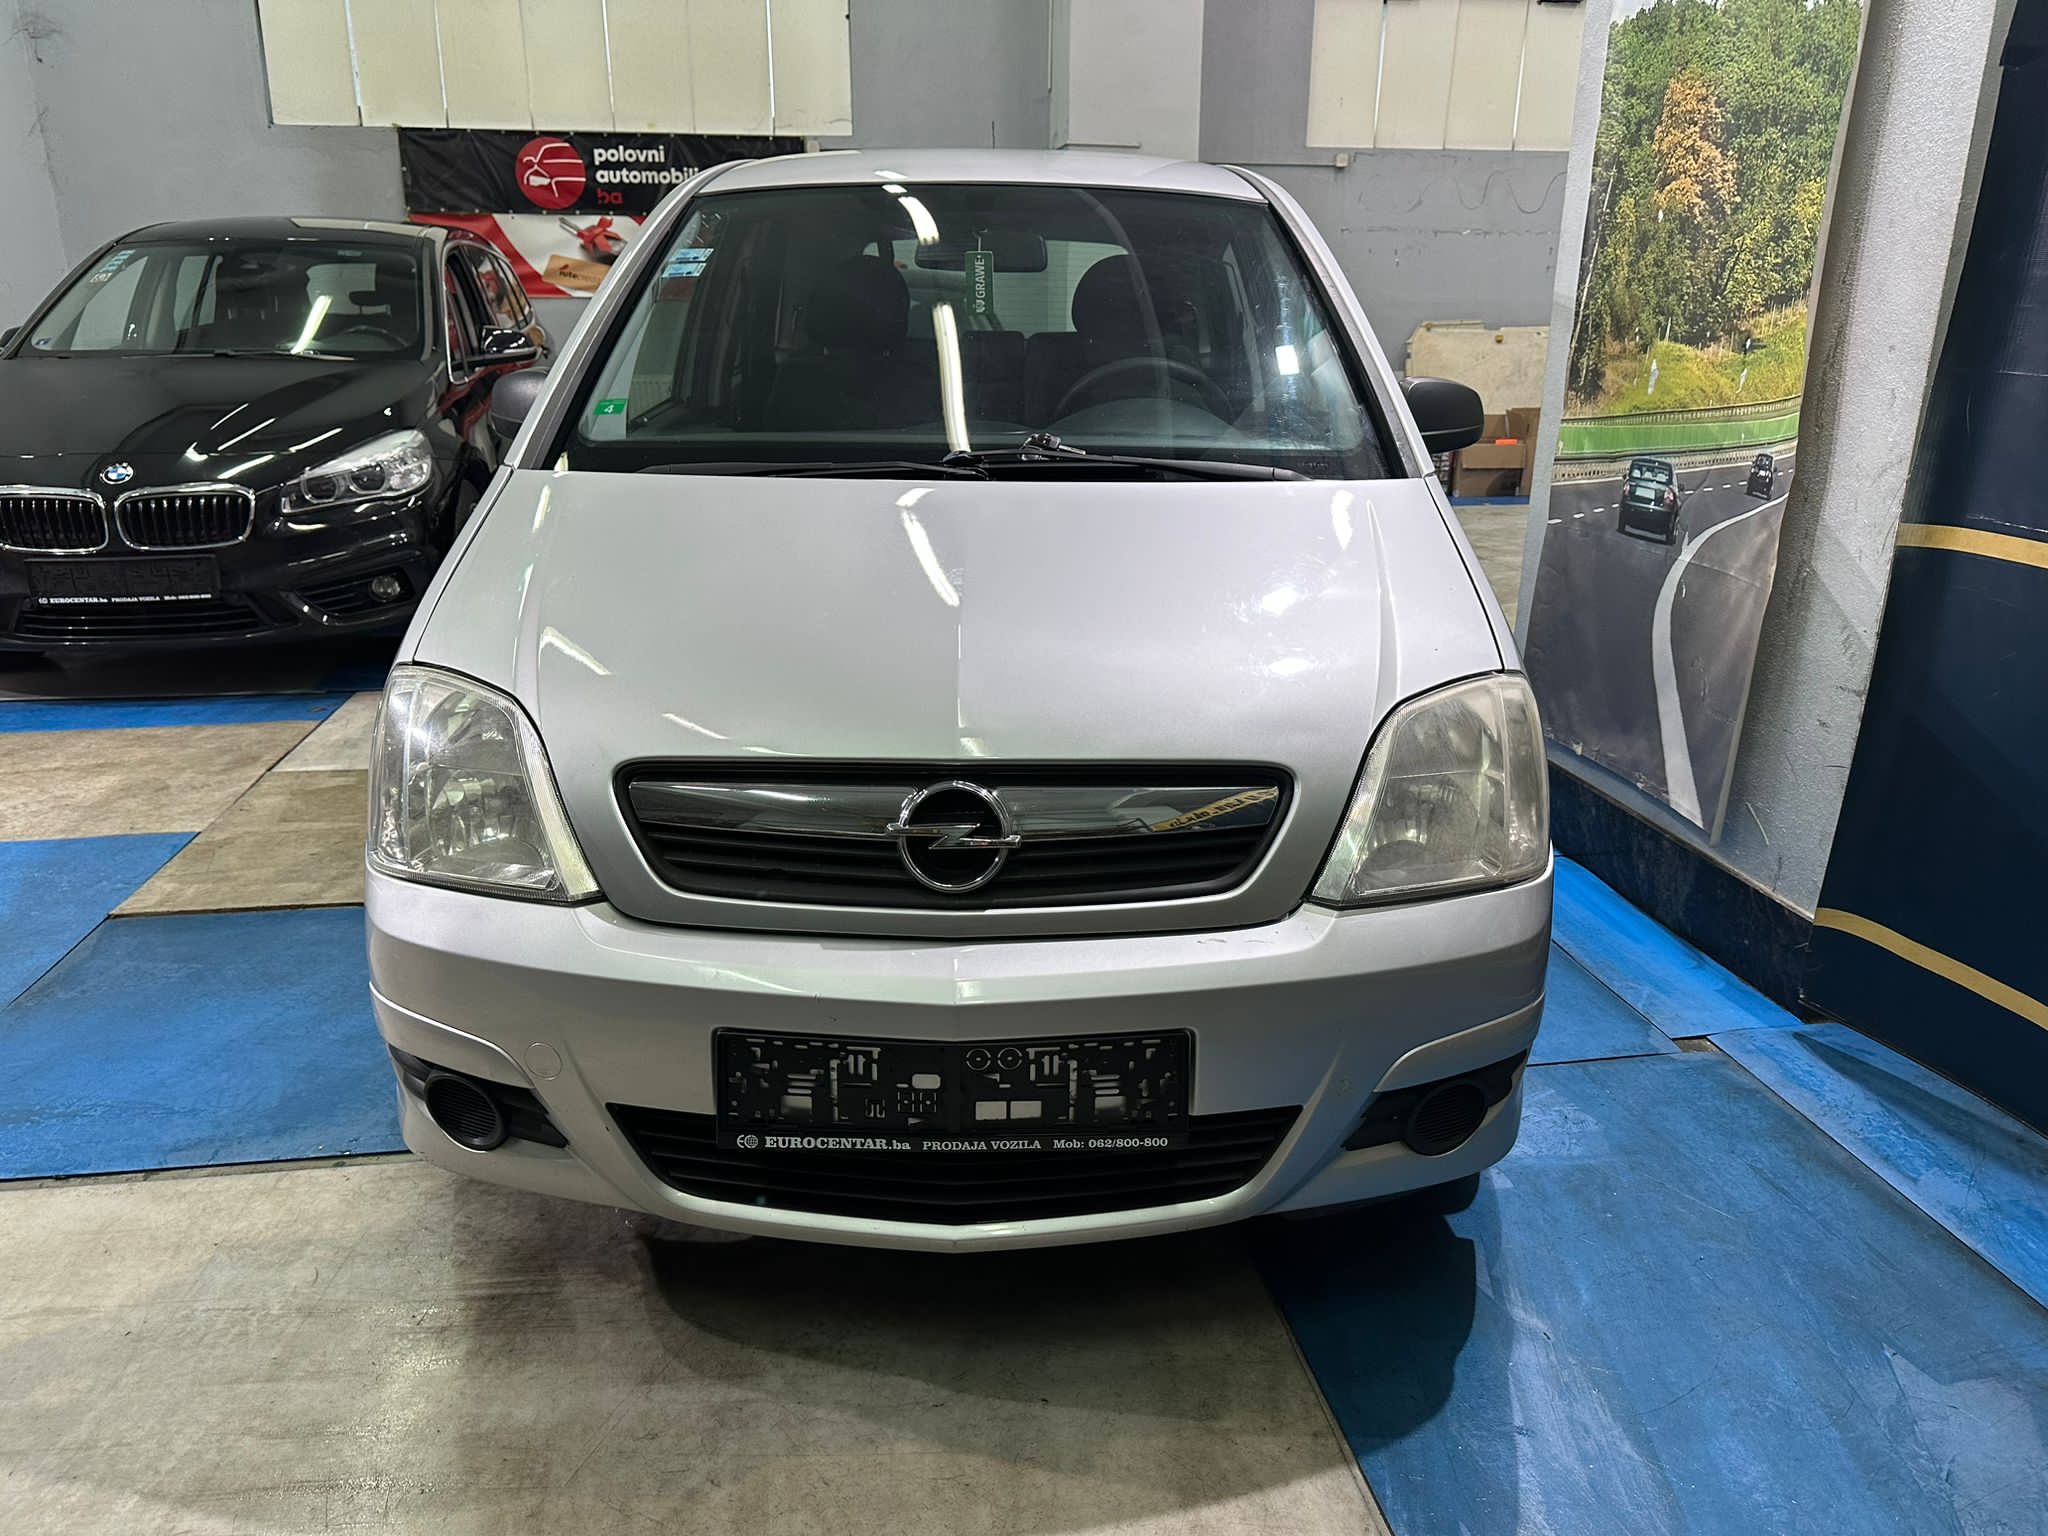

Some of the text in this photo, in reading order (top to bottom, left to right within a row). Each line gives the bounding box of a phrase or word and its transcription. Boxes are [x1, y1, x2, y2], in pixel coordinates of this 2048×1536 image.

[593, 144, 665, 166] polovni
[975, 256, 985, 299] GRAWE
[764, 1135, 1169, 1151] EUROCENTAR.ba PRODAJA VOZILA Mob: 062/800-800
